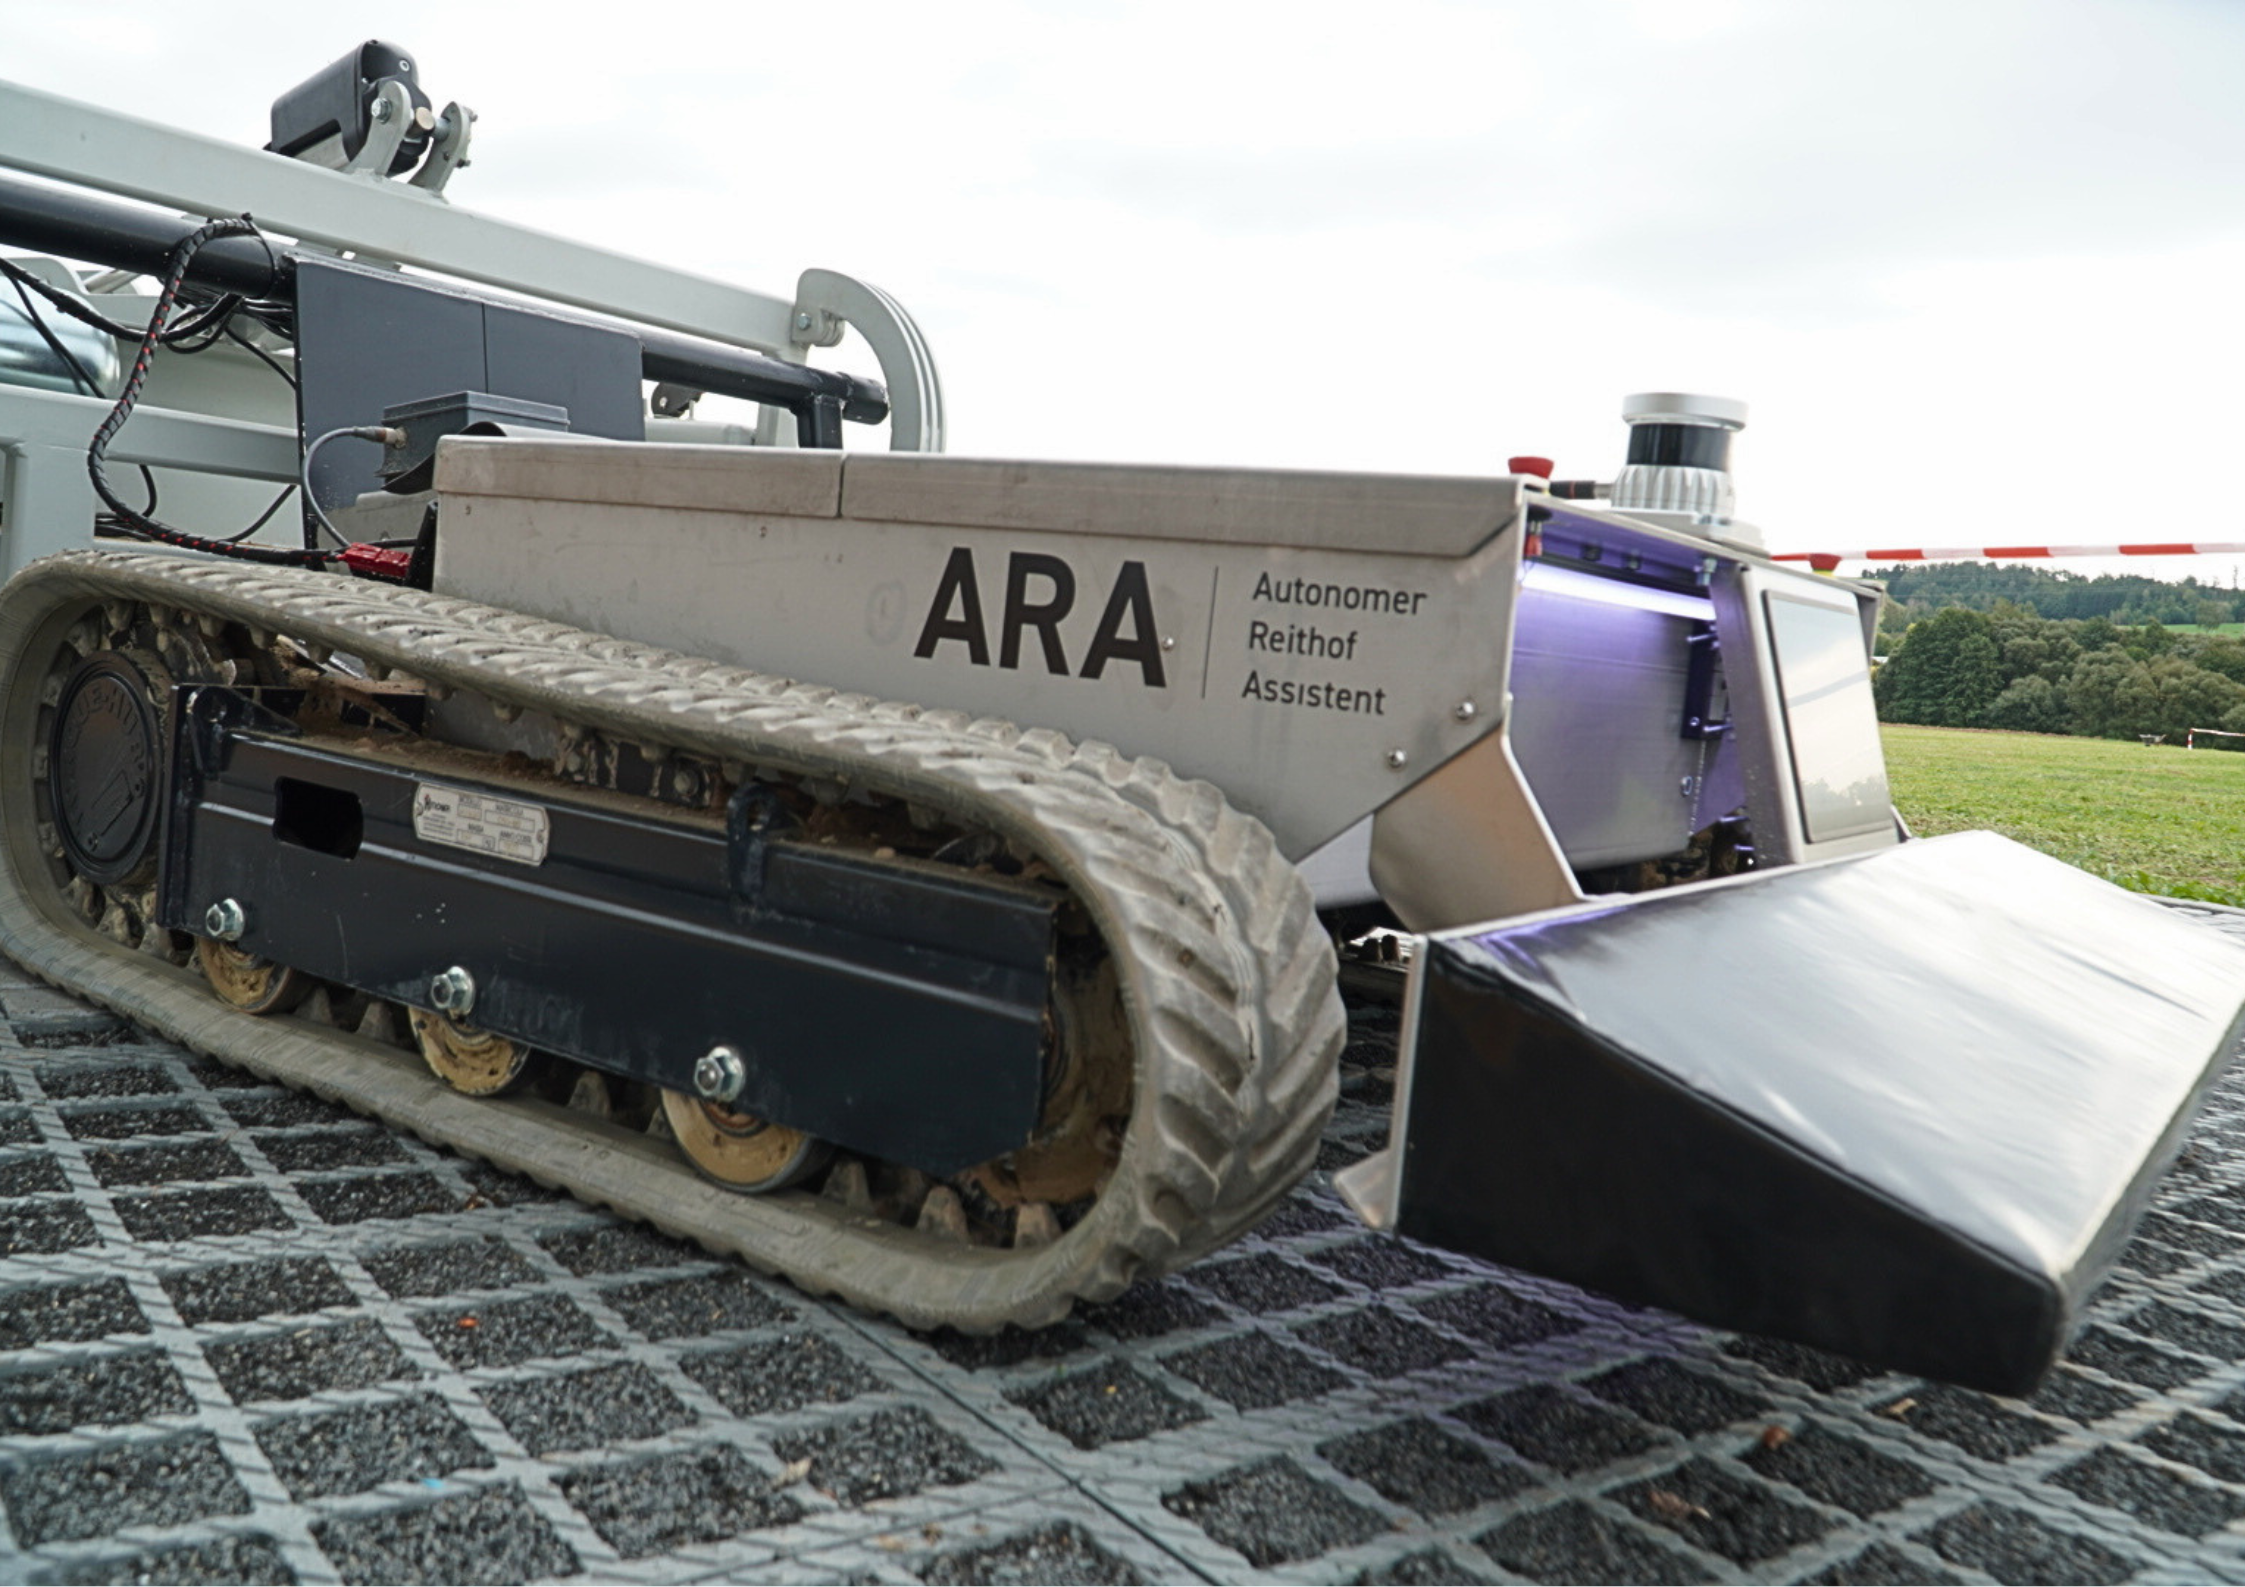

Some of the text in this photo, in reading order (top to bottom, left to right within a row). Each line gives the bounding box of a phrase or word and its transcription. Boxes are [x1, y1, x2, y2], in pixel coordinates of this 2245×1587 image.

[1253, 572, 1427, 615] Autonomer
[914, 547, 1166, 688] ARA
[1249, 621, 1357, 660] Reithof
[1242, 670, 1385, 715] Assistent
